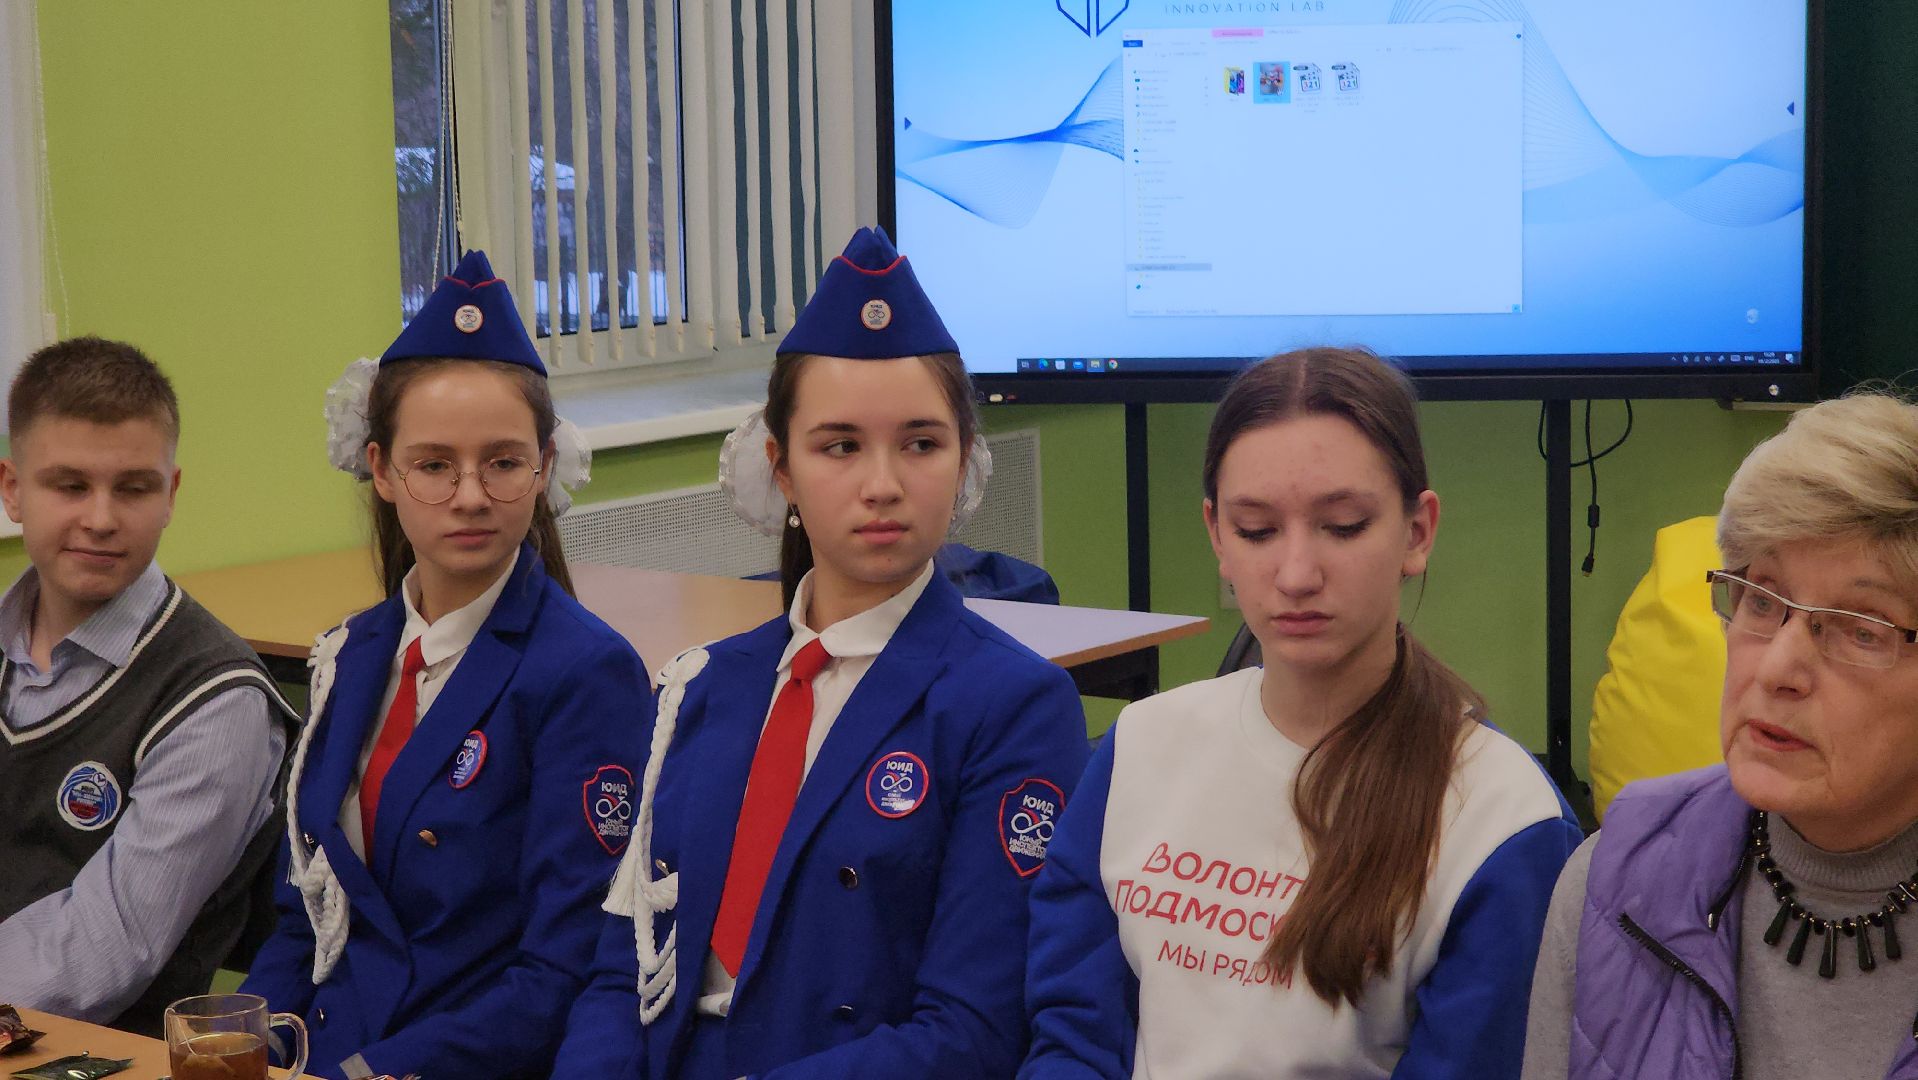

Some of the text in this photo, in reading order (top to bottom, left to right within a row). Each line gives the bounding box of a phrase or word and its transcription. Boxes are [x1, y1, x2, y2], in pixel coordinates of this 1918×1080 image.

[1165, 1, 1324, 14] INNOVATION LAB
[886, 760, 914, 774] ЮИД
[601, 781, 628, 797] ЮИД
[1022, 794, 1055, 817] ЮИД
[1141, 842, 1306, 900] ВОЛОНТ
[1115, 879, 1286, 942] ПОДМОСК
[1157, 939, 1207, 972] МЫ
